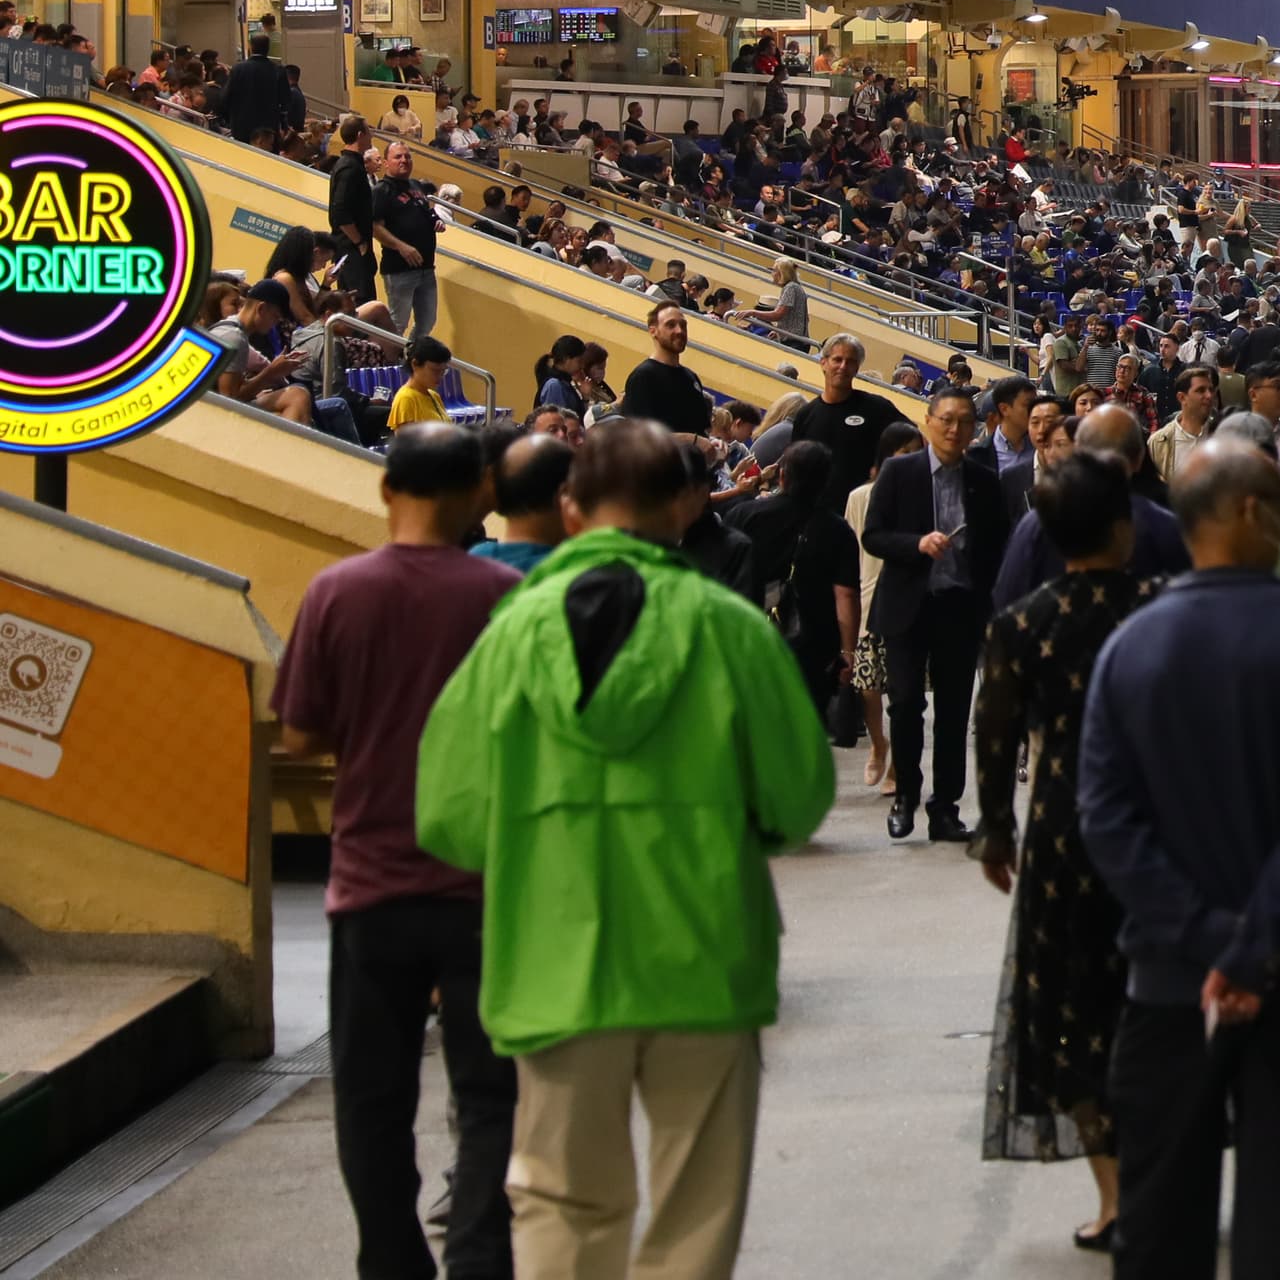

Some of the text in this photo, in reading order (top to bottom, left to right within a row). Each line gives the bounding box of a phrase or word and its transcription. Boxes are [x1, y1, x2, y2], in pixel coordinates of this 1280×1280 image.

[486, 22, 494, 44] B
[71, 394, 154, 434] Gaming
[167, 352, 201, 386] Fun
